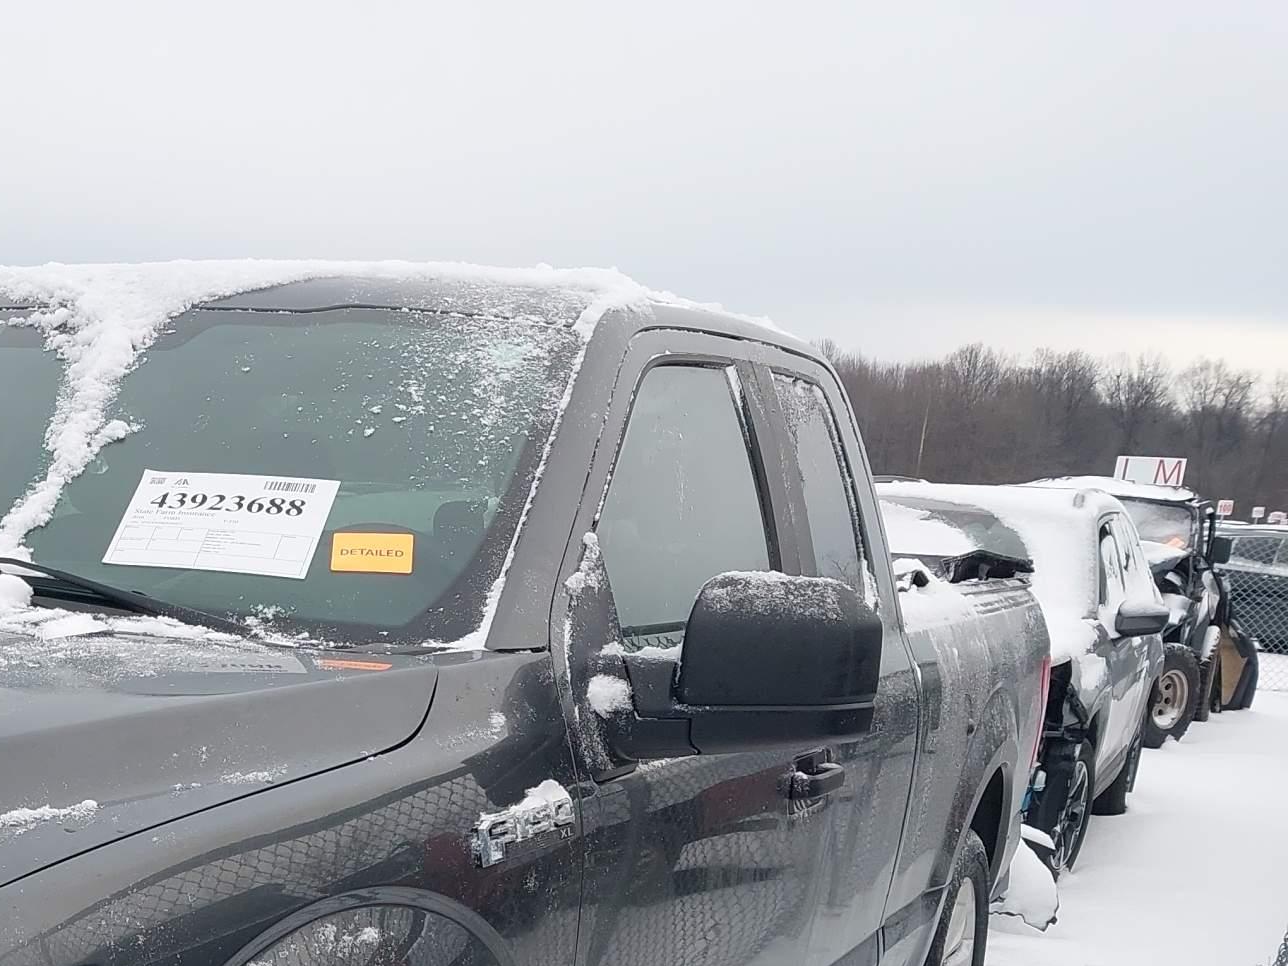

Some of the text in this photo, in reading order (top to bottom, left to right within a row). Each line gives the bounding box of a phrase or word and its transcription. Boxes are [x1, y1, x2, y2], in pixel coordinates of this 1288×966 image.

[1153, 459, 1184, 485] M
[149, 491, 307, 517] 43923688
[340, 547, 404, 559] DETAILED
[559, 827, 575, 840] XL
